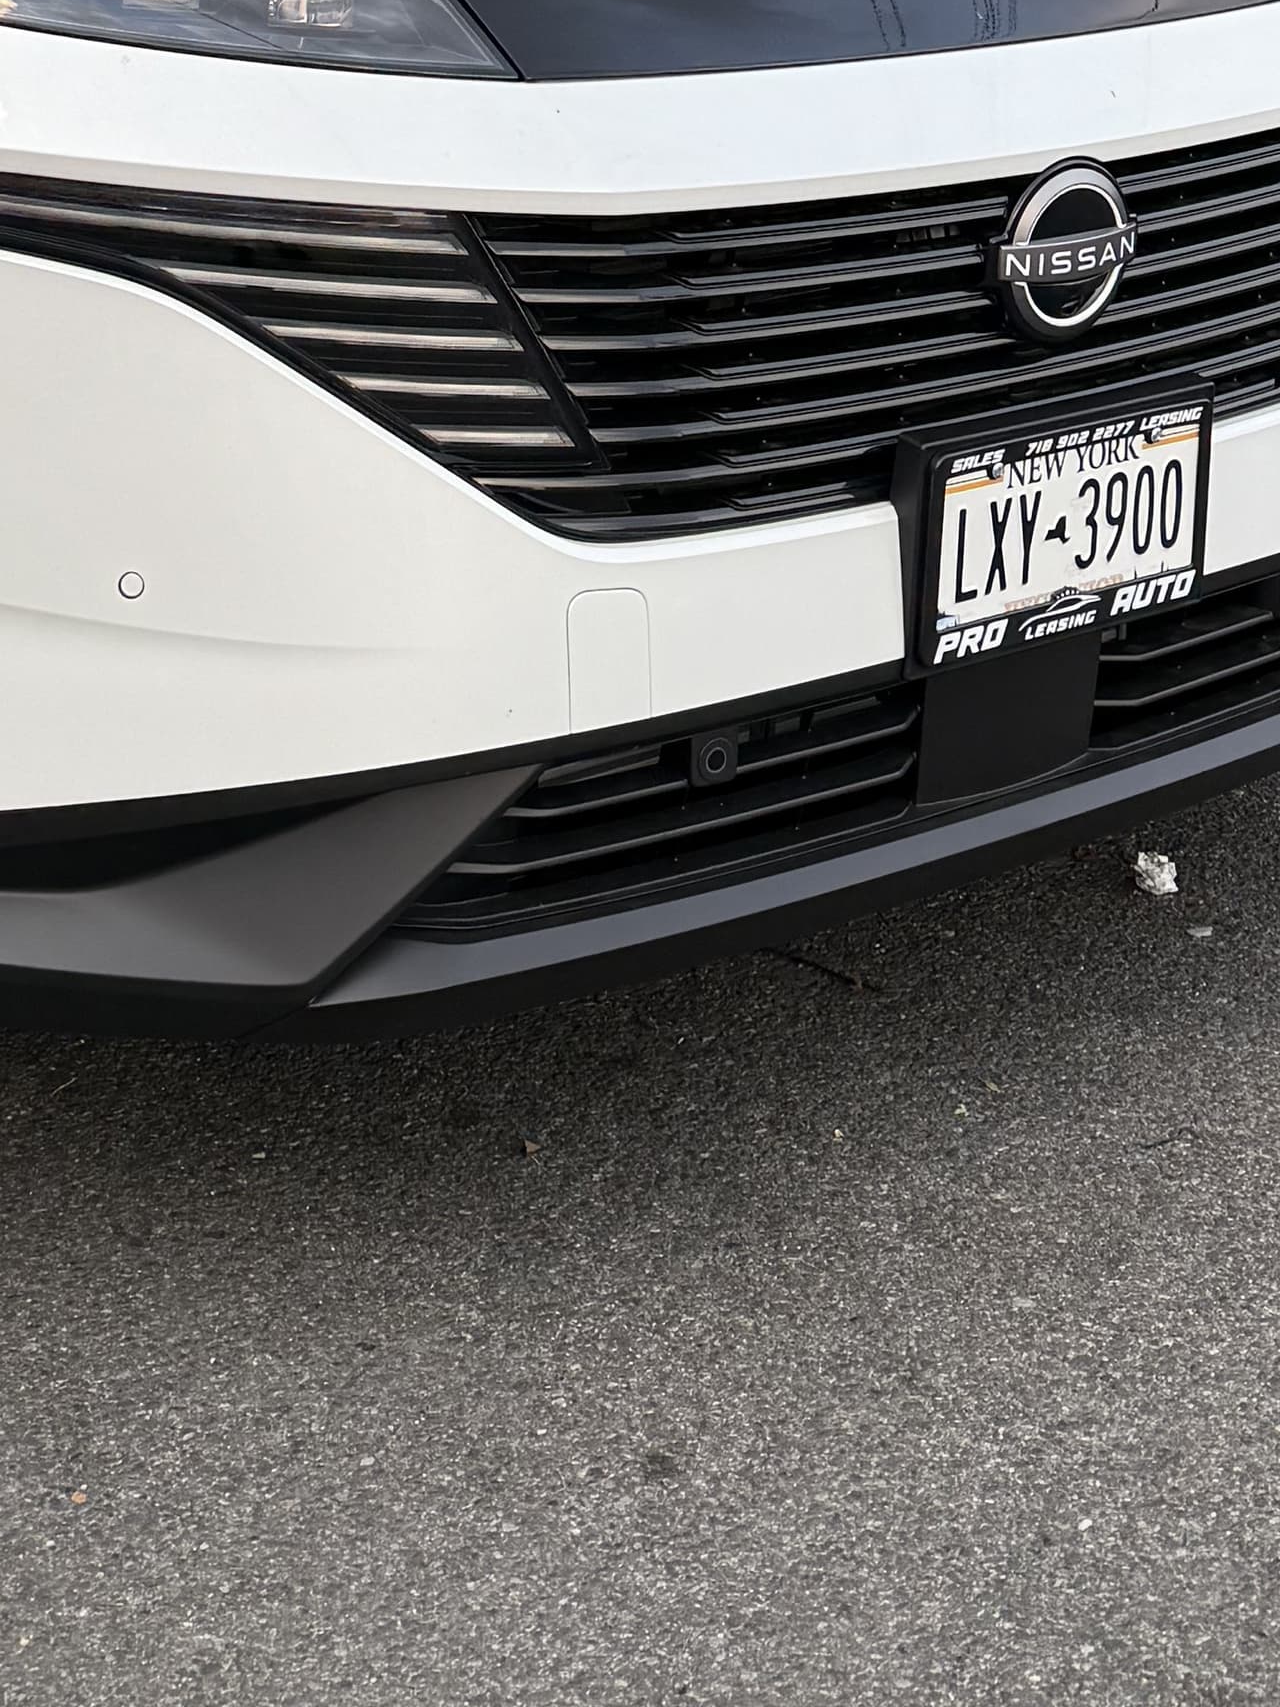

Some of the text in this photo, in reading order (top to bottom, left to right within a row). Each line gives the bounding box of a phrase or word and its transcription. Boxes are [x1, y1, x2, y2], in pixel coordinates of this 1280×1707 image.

[1005, 231, 1135, 277] NISSAN
[950, 406, 1203, 474] SALES 718 902 2277 LEASING
[1007, 436, 1140, 489] NEW YORK
[955, 459, 1183, 604] LXY 3900
[933, 619, 1008, 665] PRO
[1024, 609, 1096, 641] LEASING
[1110, 569, 1196, 617] AUTO
